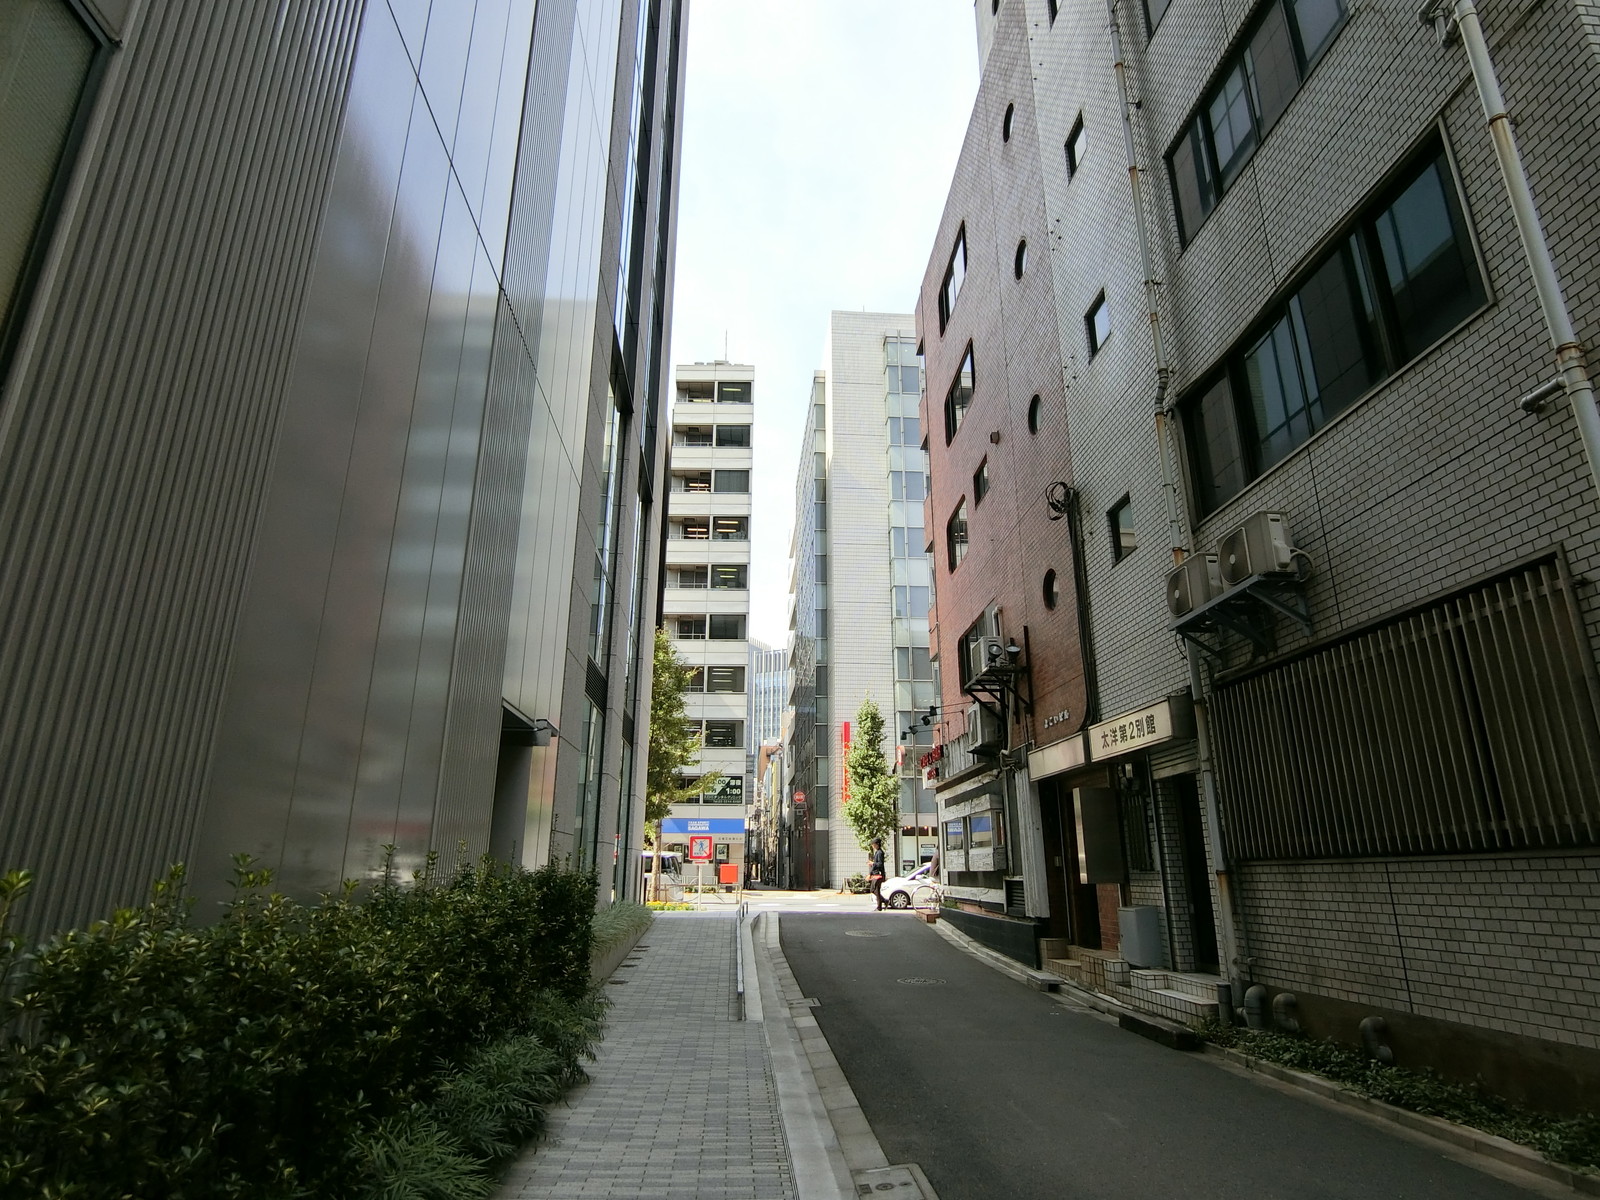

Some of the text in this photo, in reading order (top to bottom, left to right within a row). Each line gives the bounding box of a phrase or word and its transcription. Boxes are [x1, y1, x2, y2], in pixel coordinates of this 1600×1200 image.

[1101, 714, 1156, 749] 太洋第2別館
